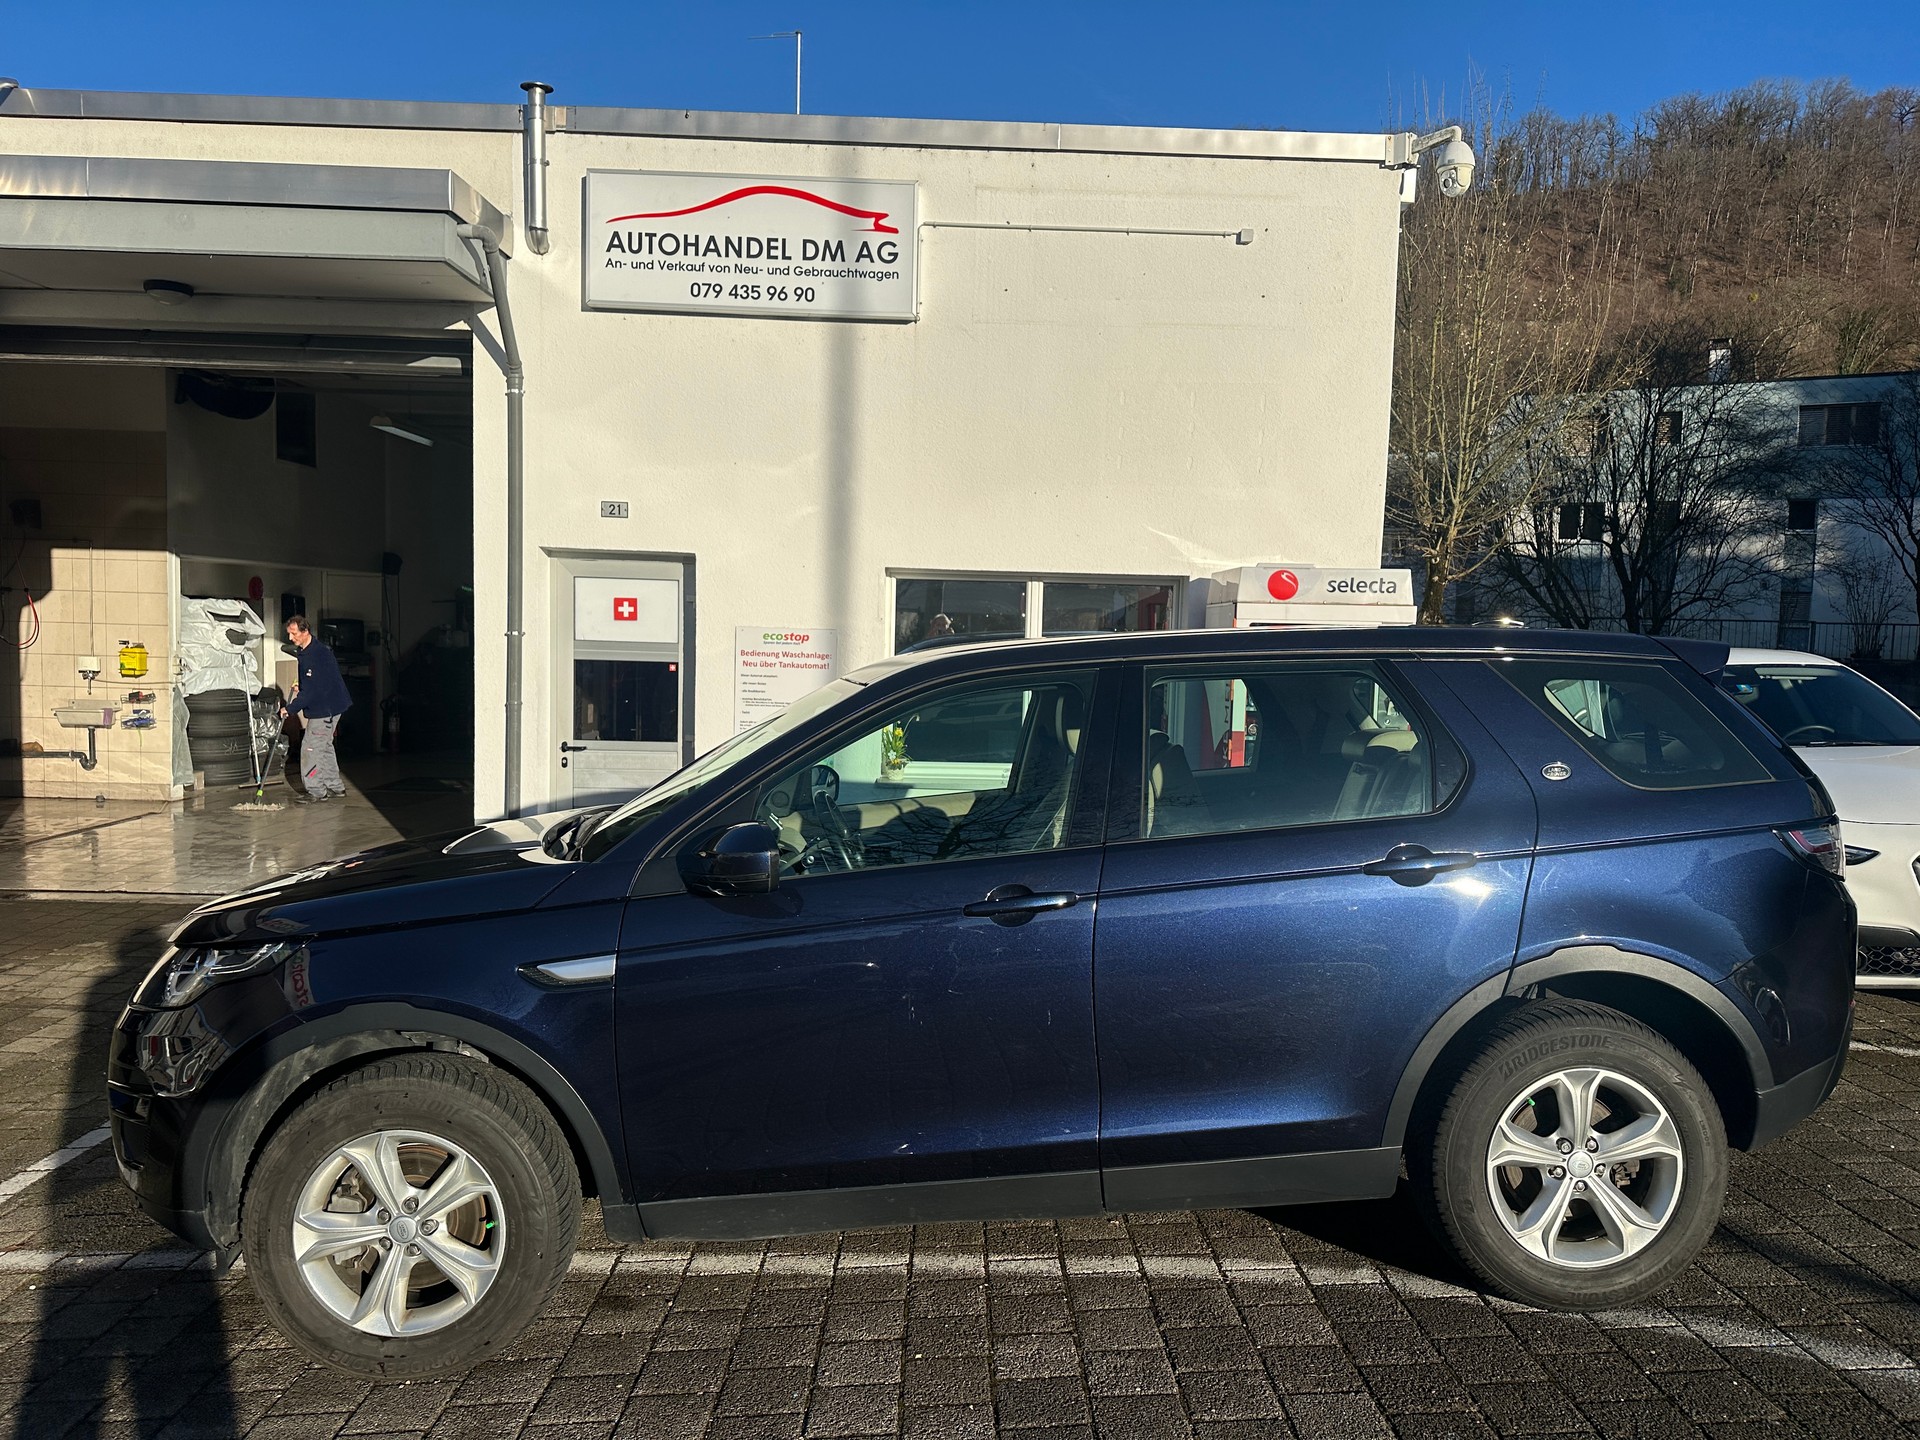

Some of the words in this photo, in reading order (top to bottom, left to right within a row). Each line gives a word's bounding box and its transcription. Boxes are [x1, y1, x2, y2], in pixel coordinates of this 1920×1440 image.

[606, 231, 792, 261] AUTOHANDEL
[802, 239, 846, 263] DM
[855, 241, 899, 264] AG
[605, 258, 627, 269] An-
[631, 259, 654, 271] und
[658, 260, 706, 273] Verkauf
[708, 265, 731, 274] von
[734, 263, 764, 275] Neu-
[767, 264, 790, 276] und
[793, 265, 899, 282] Gebrauchtwagen
[690, 282, 723, 299] 079
[728, 284, 761, 301] 435
[766, 285, 788, 302] 96
[794, 286, 815, 303] 90
[608, 503, 622, 516] 21
[1326, 577, 1397, 594] selecta
[762, 632, 810, 643] ecostop
[740, 649, 780, 659] Bedienung
[781, 651, 832, 660] Waschanlage:
[759, 660, 777, 668] über
[779, 661, 830, 670] Tankautomat!
[1497, 1034, 1612, 1081] BRIDGESTONE
